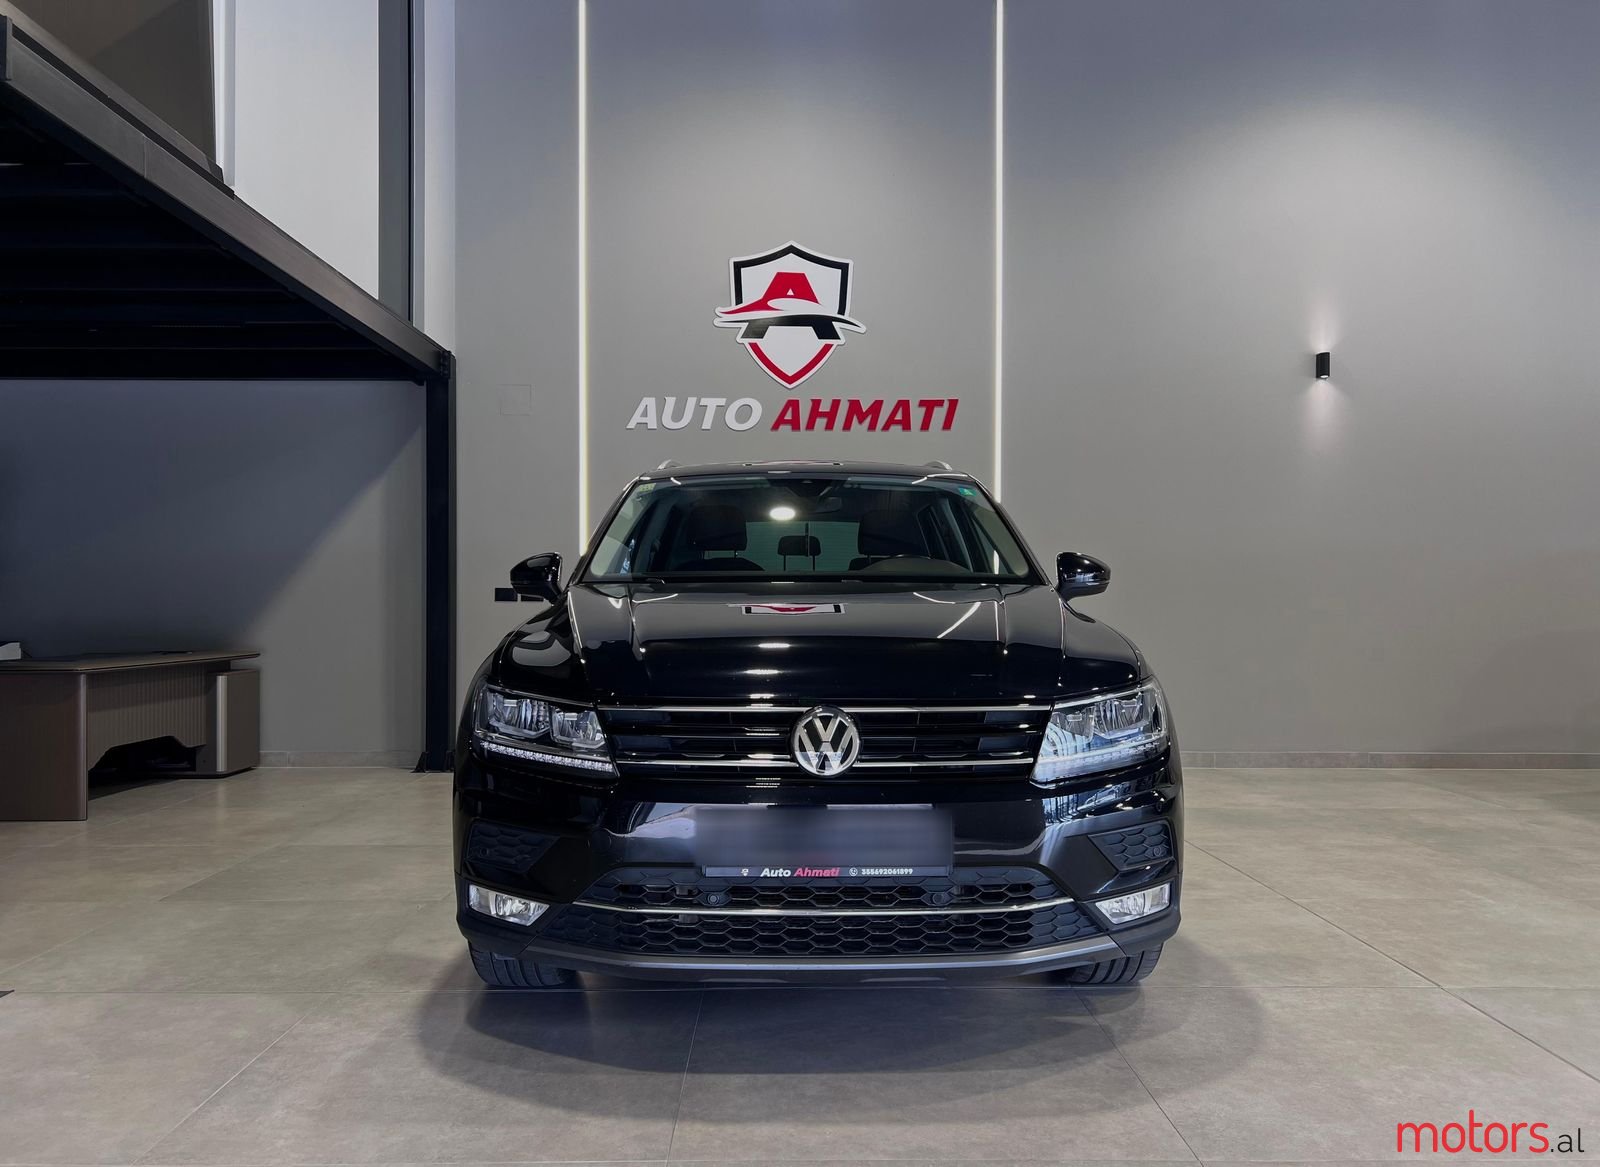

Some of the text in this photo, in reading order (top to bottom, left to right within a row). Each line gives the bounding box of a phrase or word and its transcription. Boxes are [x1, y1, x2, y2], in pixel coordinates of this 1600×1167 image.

[626, 397, 959, 432] AUTO AHMATI
[794, 711, 860, 775] VW
[760, 867, 791, 877] Auto
[794, 867, 840, 877] Ahmati
